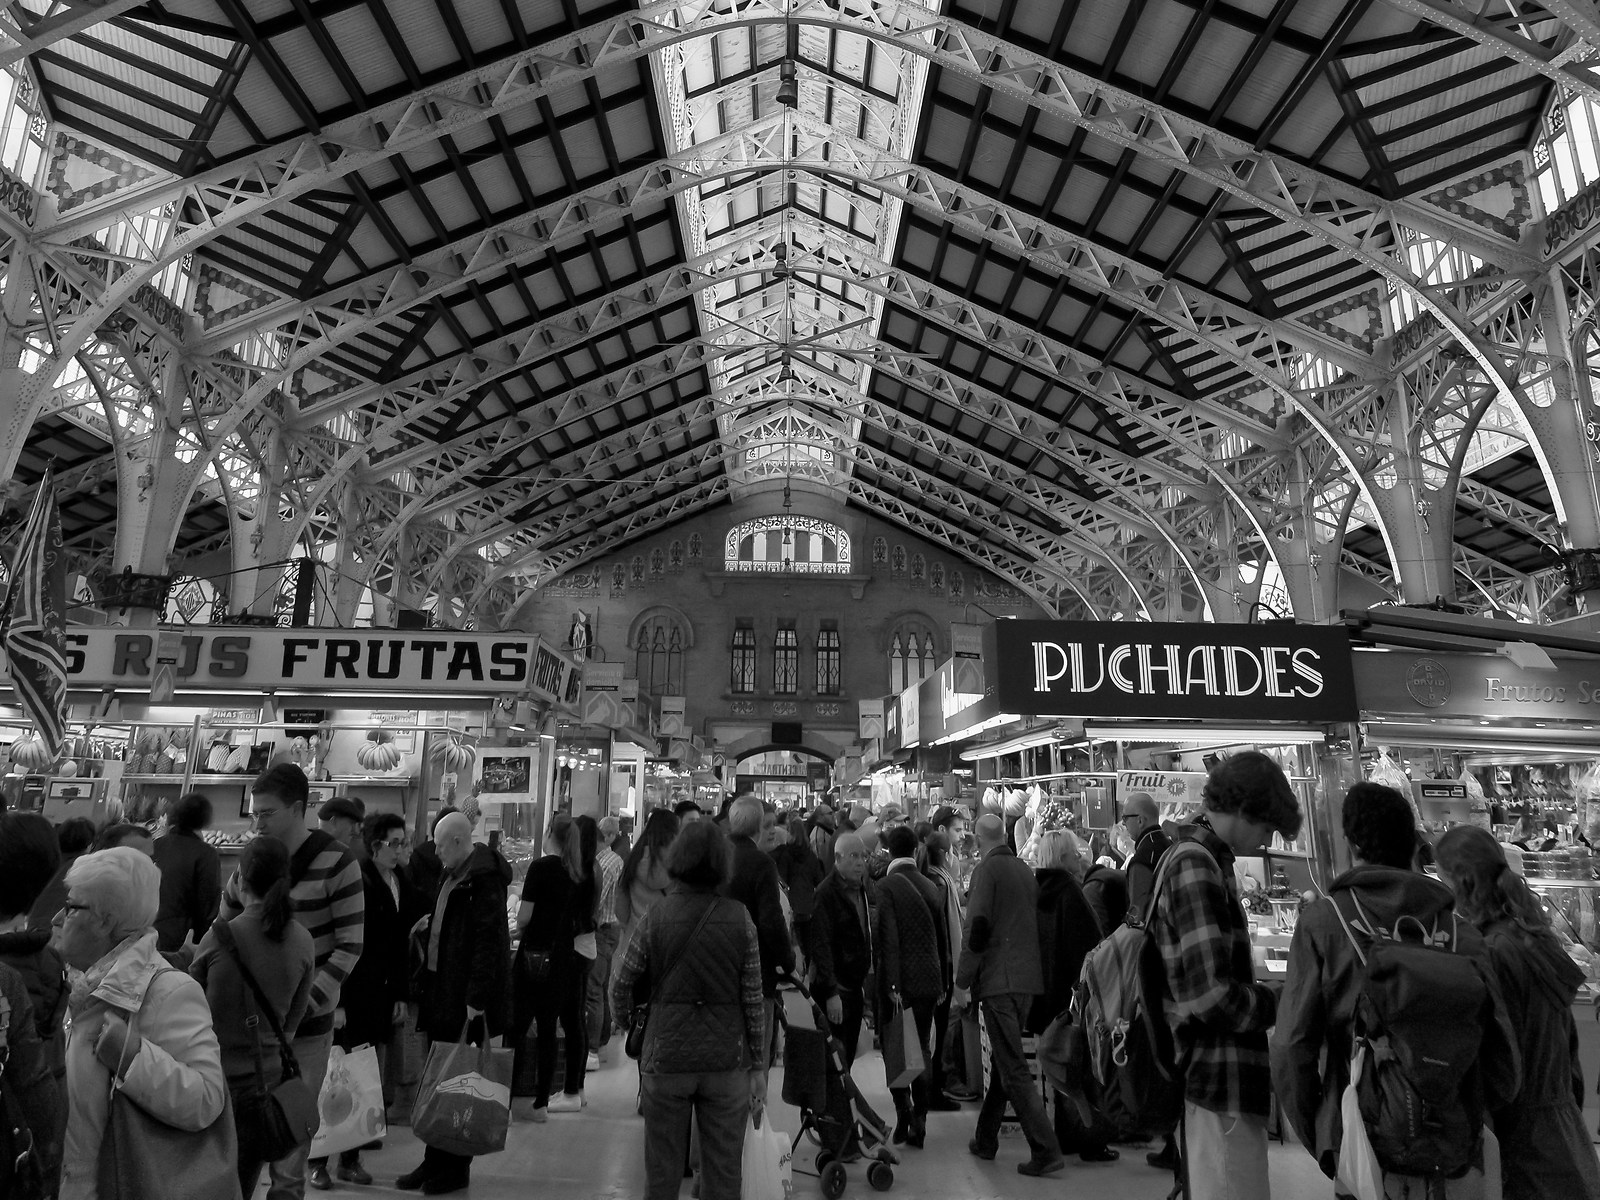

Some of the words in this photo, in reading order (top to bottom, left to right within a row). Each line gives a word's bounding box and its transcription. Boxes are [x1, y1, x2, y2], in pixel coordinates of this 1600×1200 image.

[281, 638, 528, 681] FRUTAS
[1031, 642, 1324, 698] PUCHADES
[1484, 677, 1566, 704] Frutos
[1120, 772, 1167, 788] Fruit
